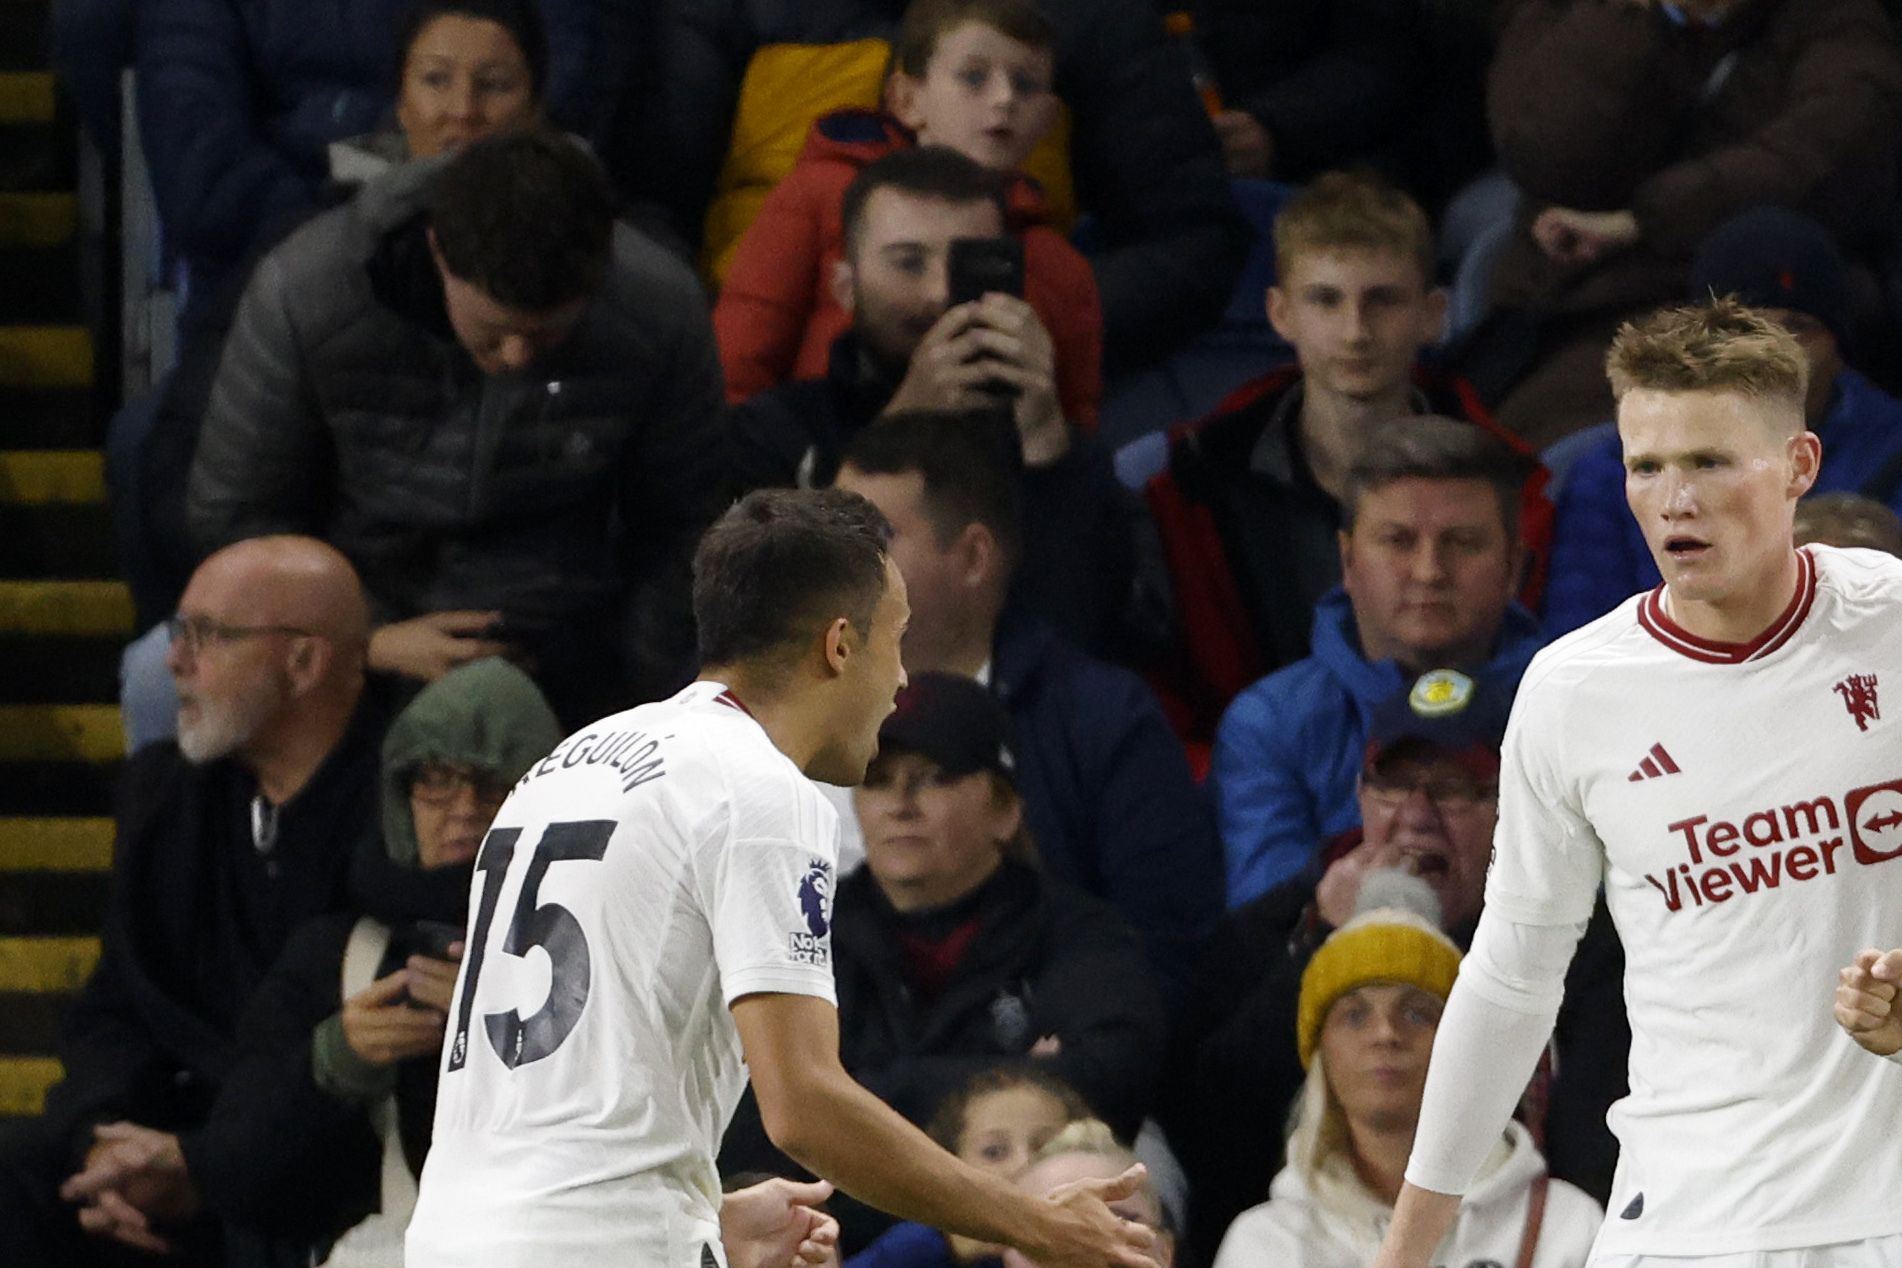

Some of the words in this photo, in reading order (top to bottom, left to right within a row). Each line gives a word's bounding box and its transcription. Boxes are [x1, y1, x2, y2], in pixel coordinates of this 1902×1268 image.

[1668, 795, 1840, 865] Team
[1644, 836, 1843, 912] Viewer
[447, 819, 618, 1072] 15
